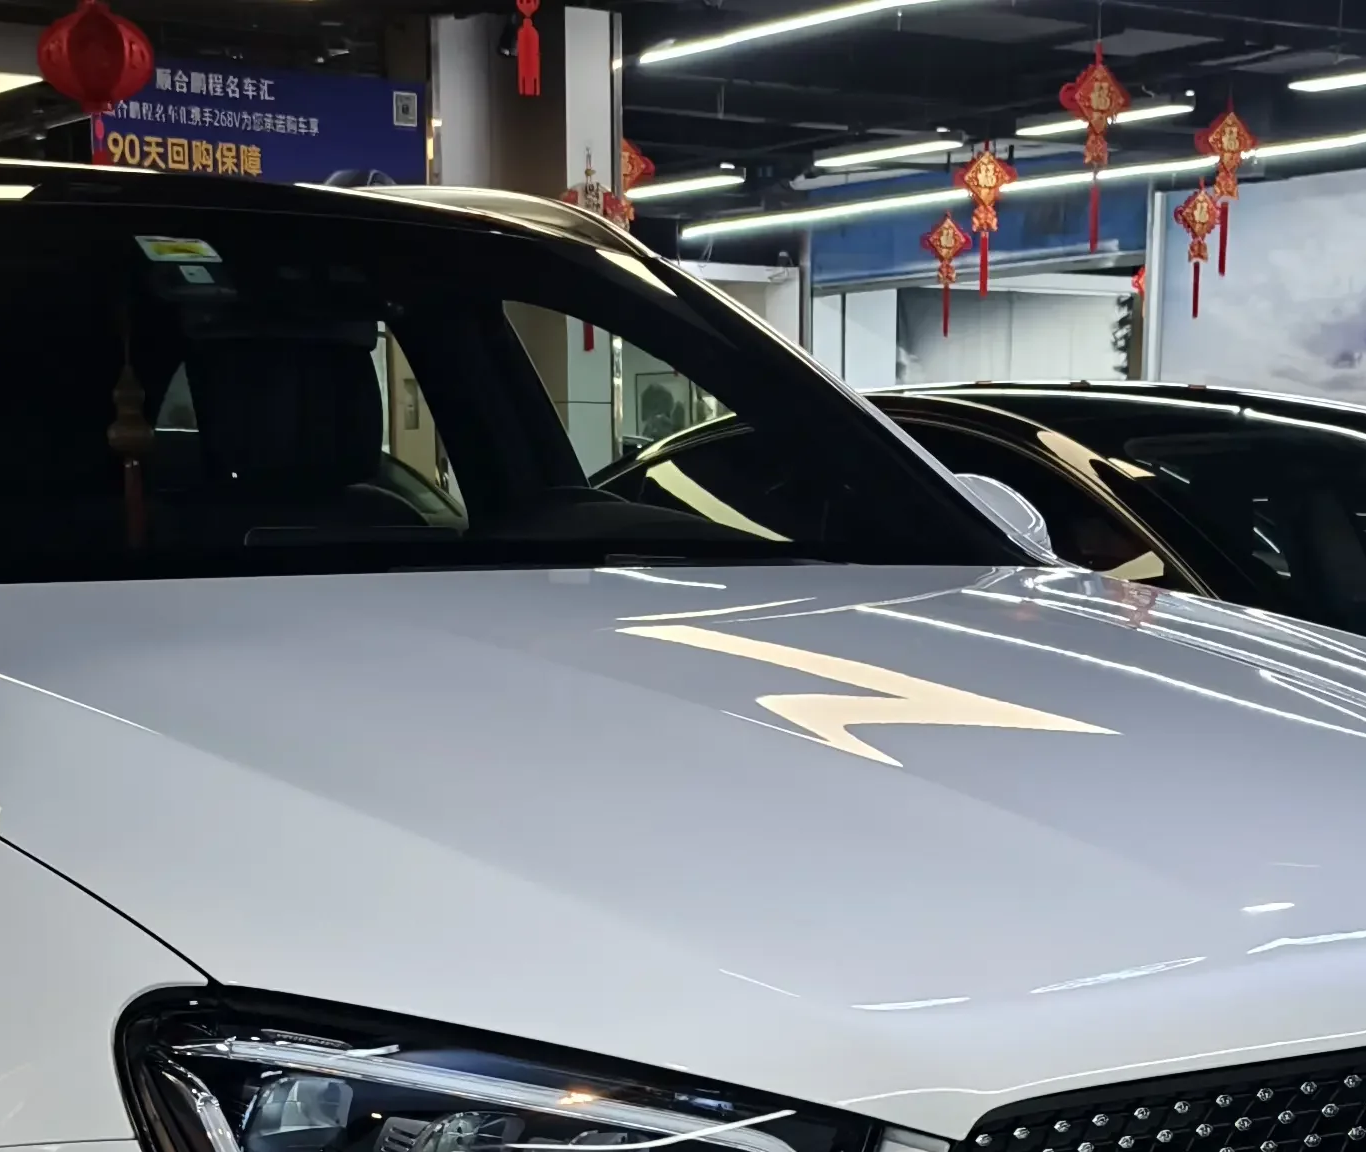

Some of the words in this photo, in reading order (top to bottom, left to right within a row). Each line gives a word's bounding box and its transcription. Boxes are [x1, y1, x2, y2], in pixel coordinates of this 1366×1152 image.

[156, 68, 275, 101] 顺合鹏程名车汇
[107, 131, 262, 176] 90天回购保障
